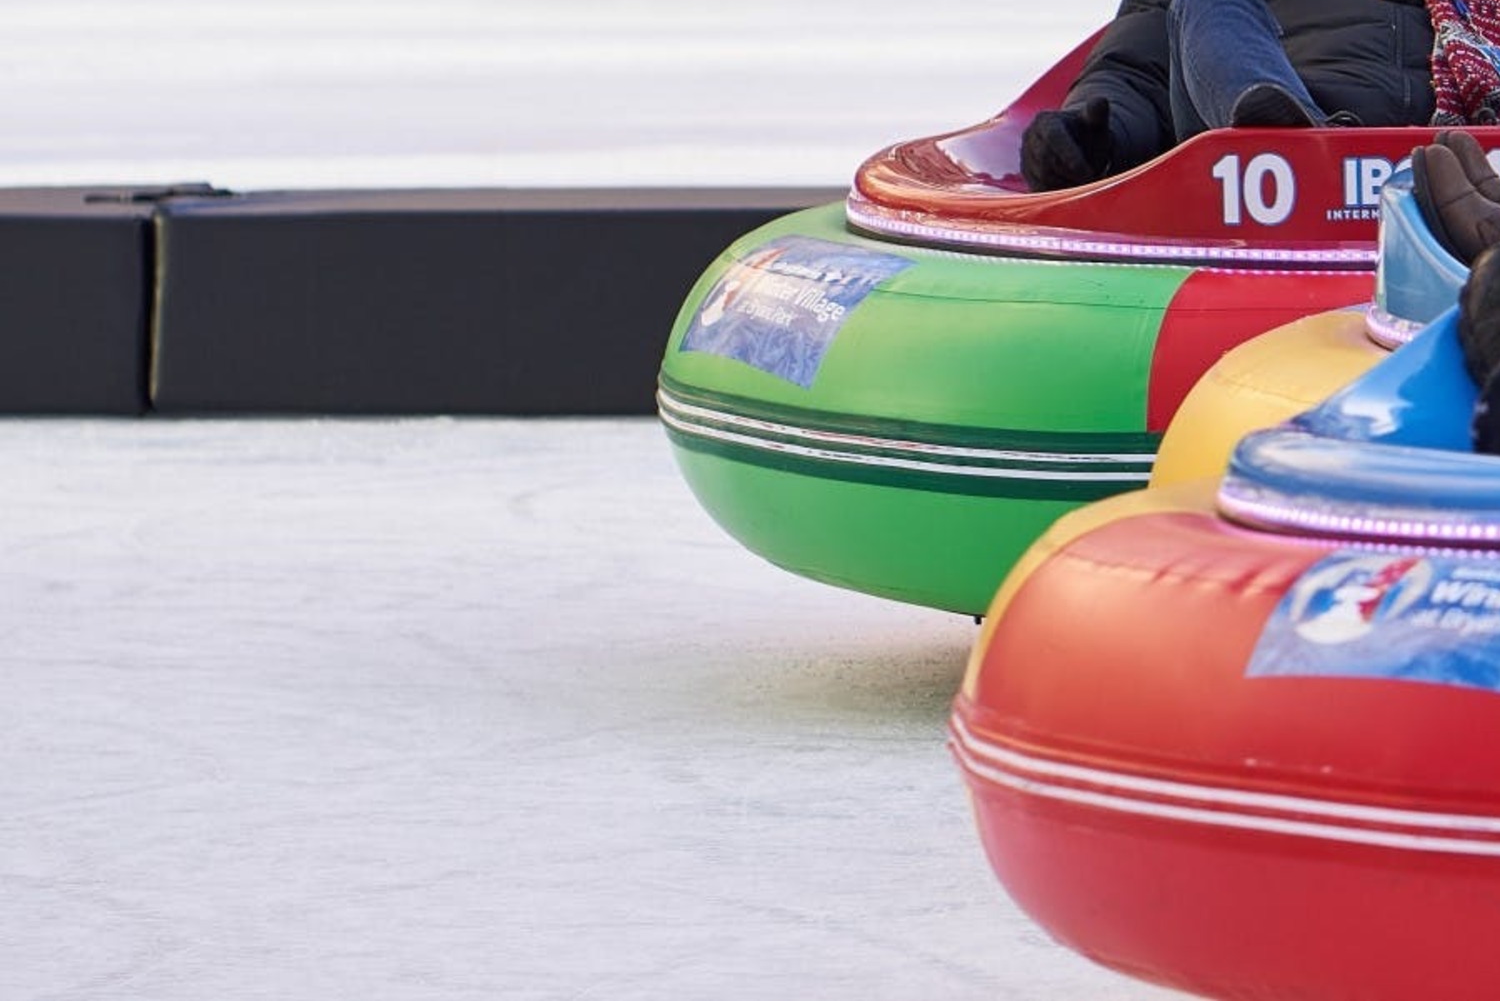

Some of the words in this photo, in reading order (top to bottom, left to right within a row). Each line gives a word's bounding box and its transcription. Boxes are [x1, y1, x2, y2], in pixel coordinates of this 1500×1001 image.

[1212, 153, 1295, 225] 10
[1343, 157, 1413, 207] IB
[794, 285, 846, 322] Village
